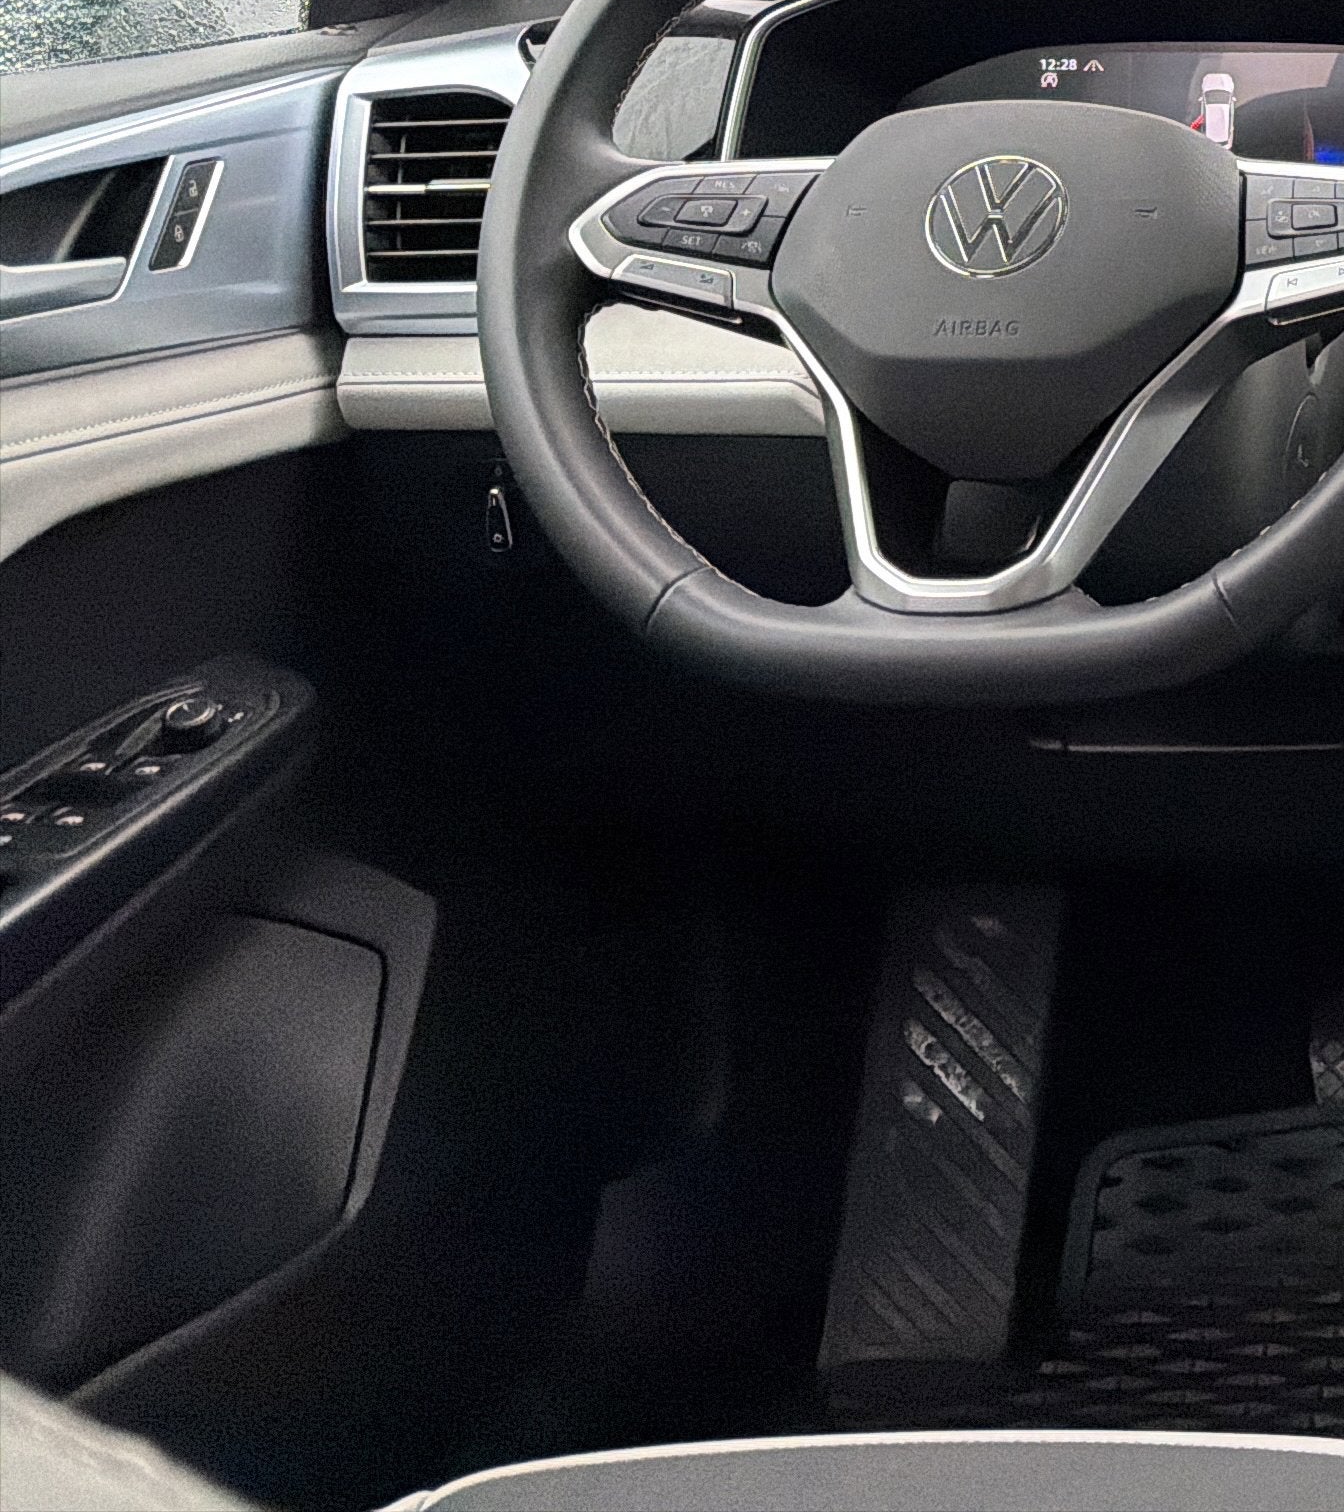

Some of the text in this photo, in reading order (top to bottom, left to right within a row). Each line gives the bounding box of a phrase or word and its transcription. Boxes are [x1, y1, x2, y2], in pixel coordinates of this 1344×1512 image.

[1039, 58, 1078, 71] 12:28
[681, 235, 702, 246] SET
[933, 318, 1020, 337] AIRBAG
